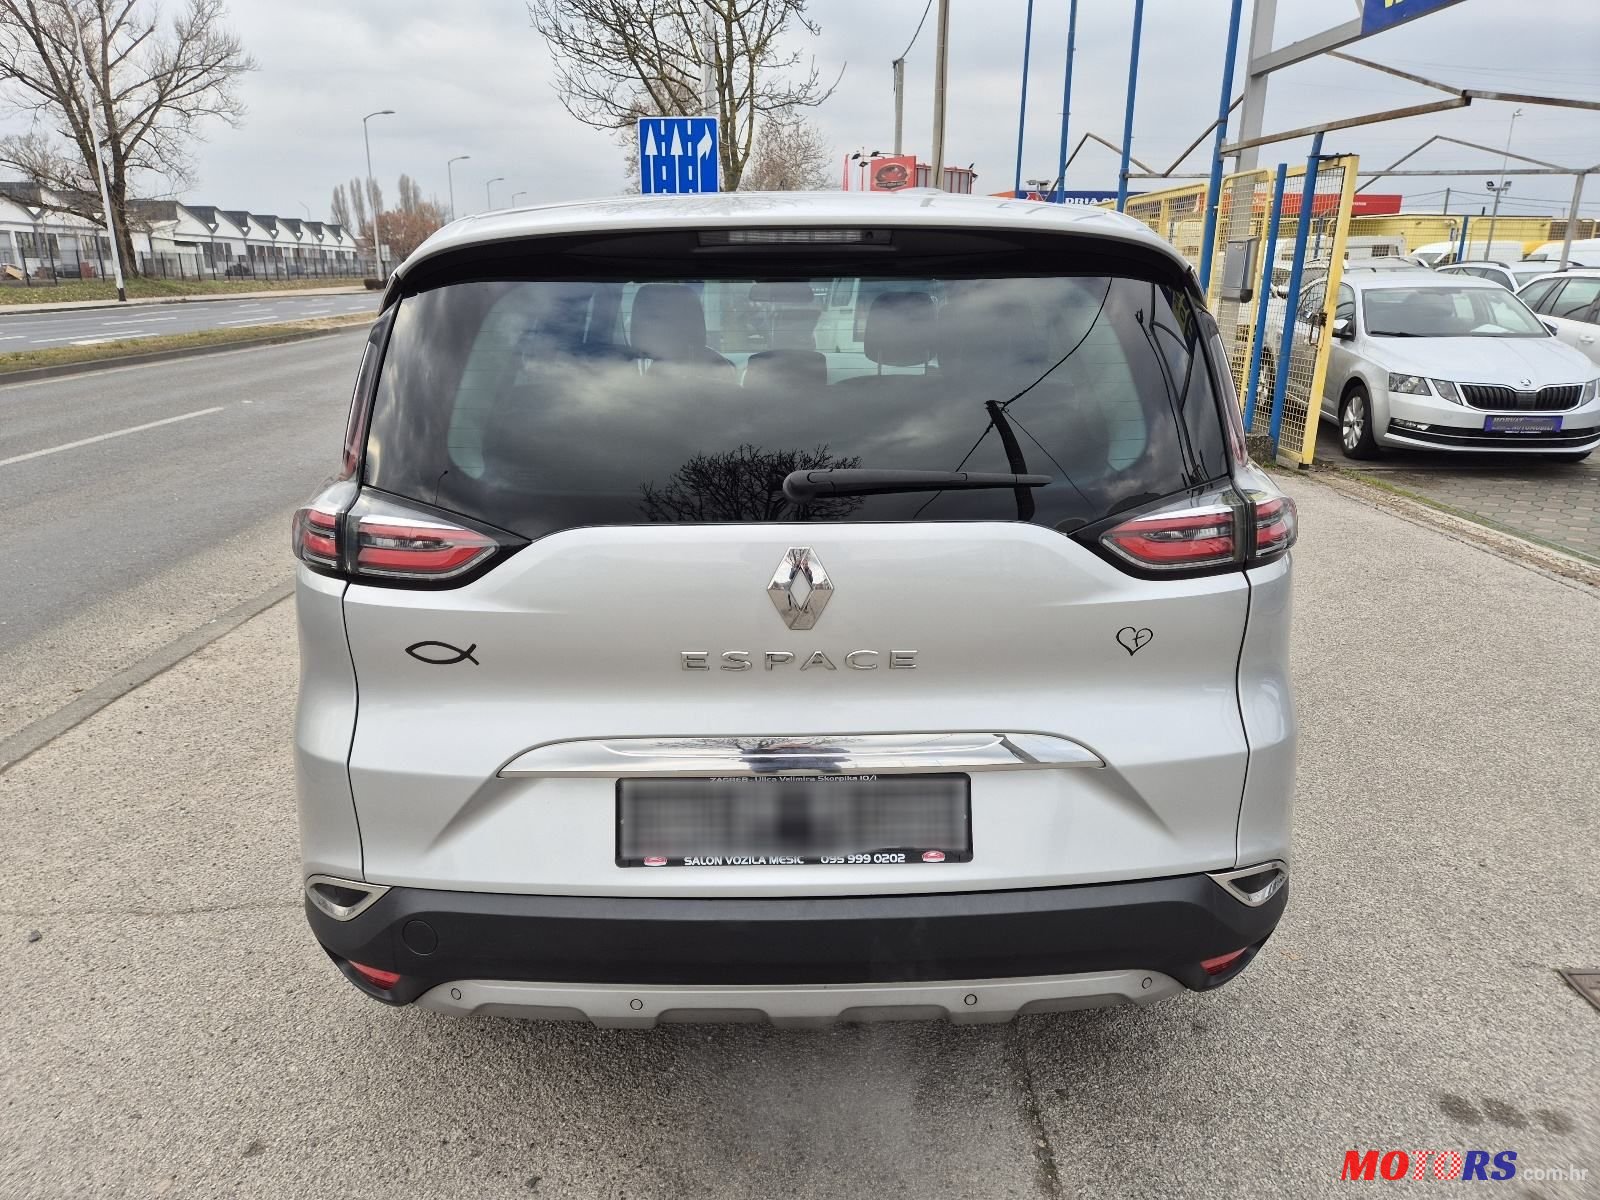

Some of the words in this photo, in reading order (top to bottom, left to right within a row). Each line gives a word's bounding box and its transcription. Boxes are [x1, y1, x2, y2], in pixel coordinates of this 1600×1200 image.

[680, 649, 919, 671] ESPACE
[684, 856, 723, 866] SALON
[725, 855, 766, 865] VOZILA
[847, 853, 871, 864] 999
[873, 853, 906, 864] 0202
